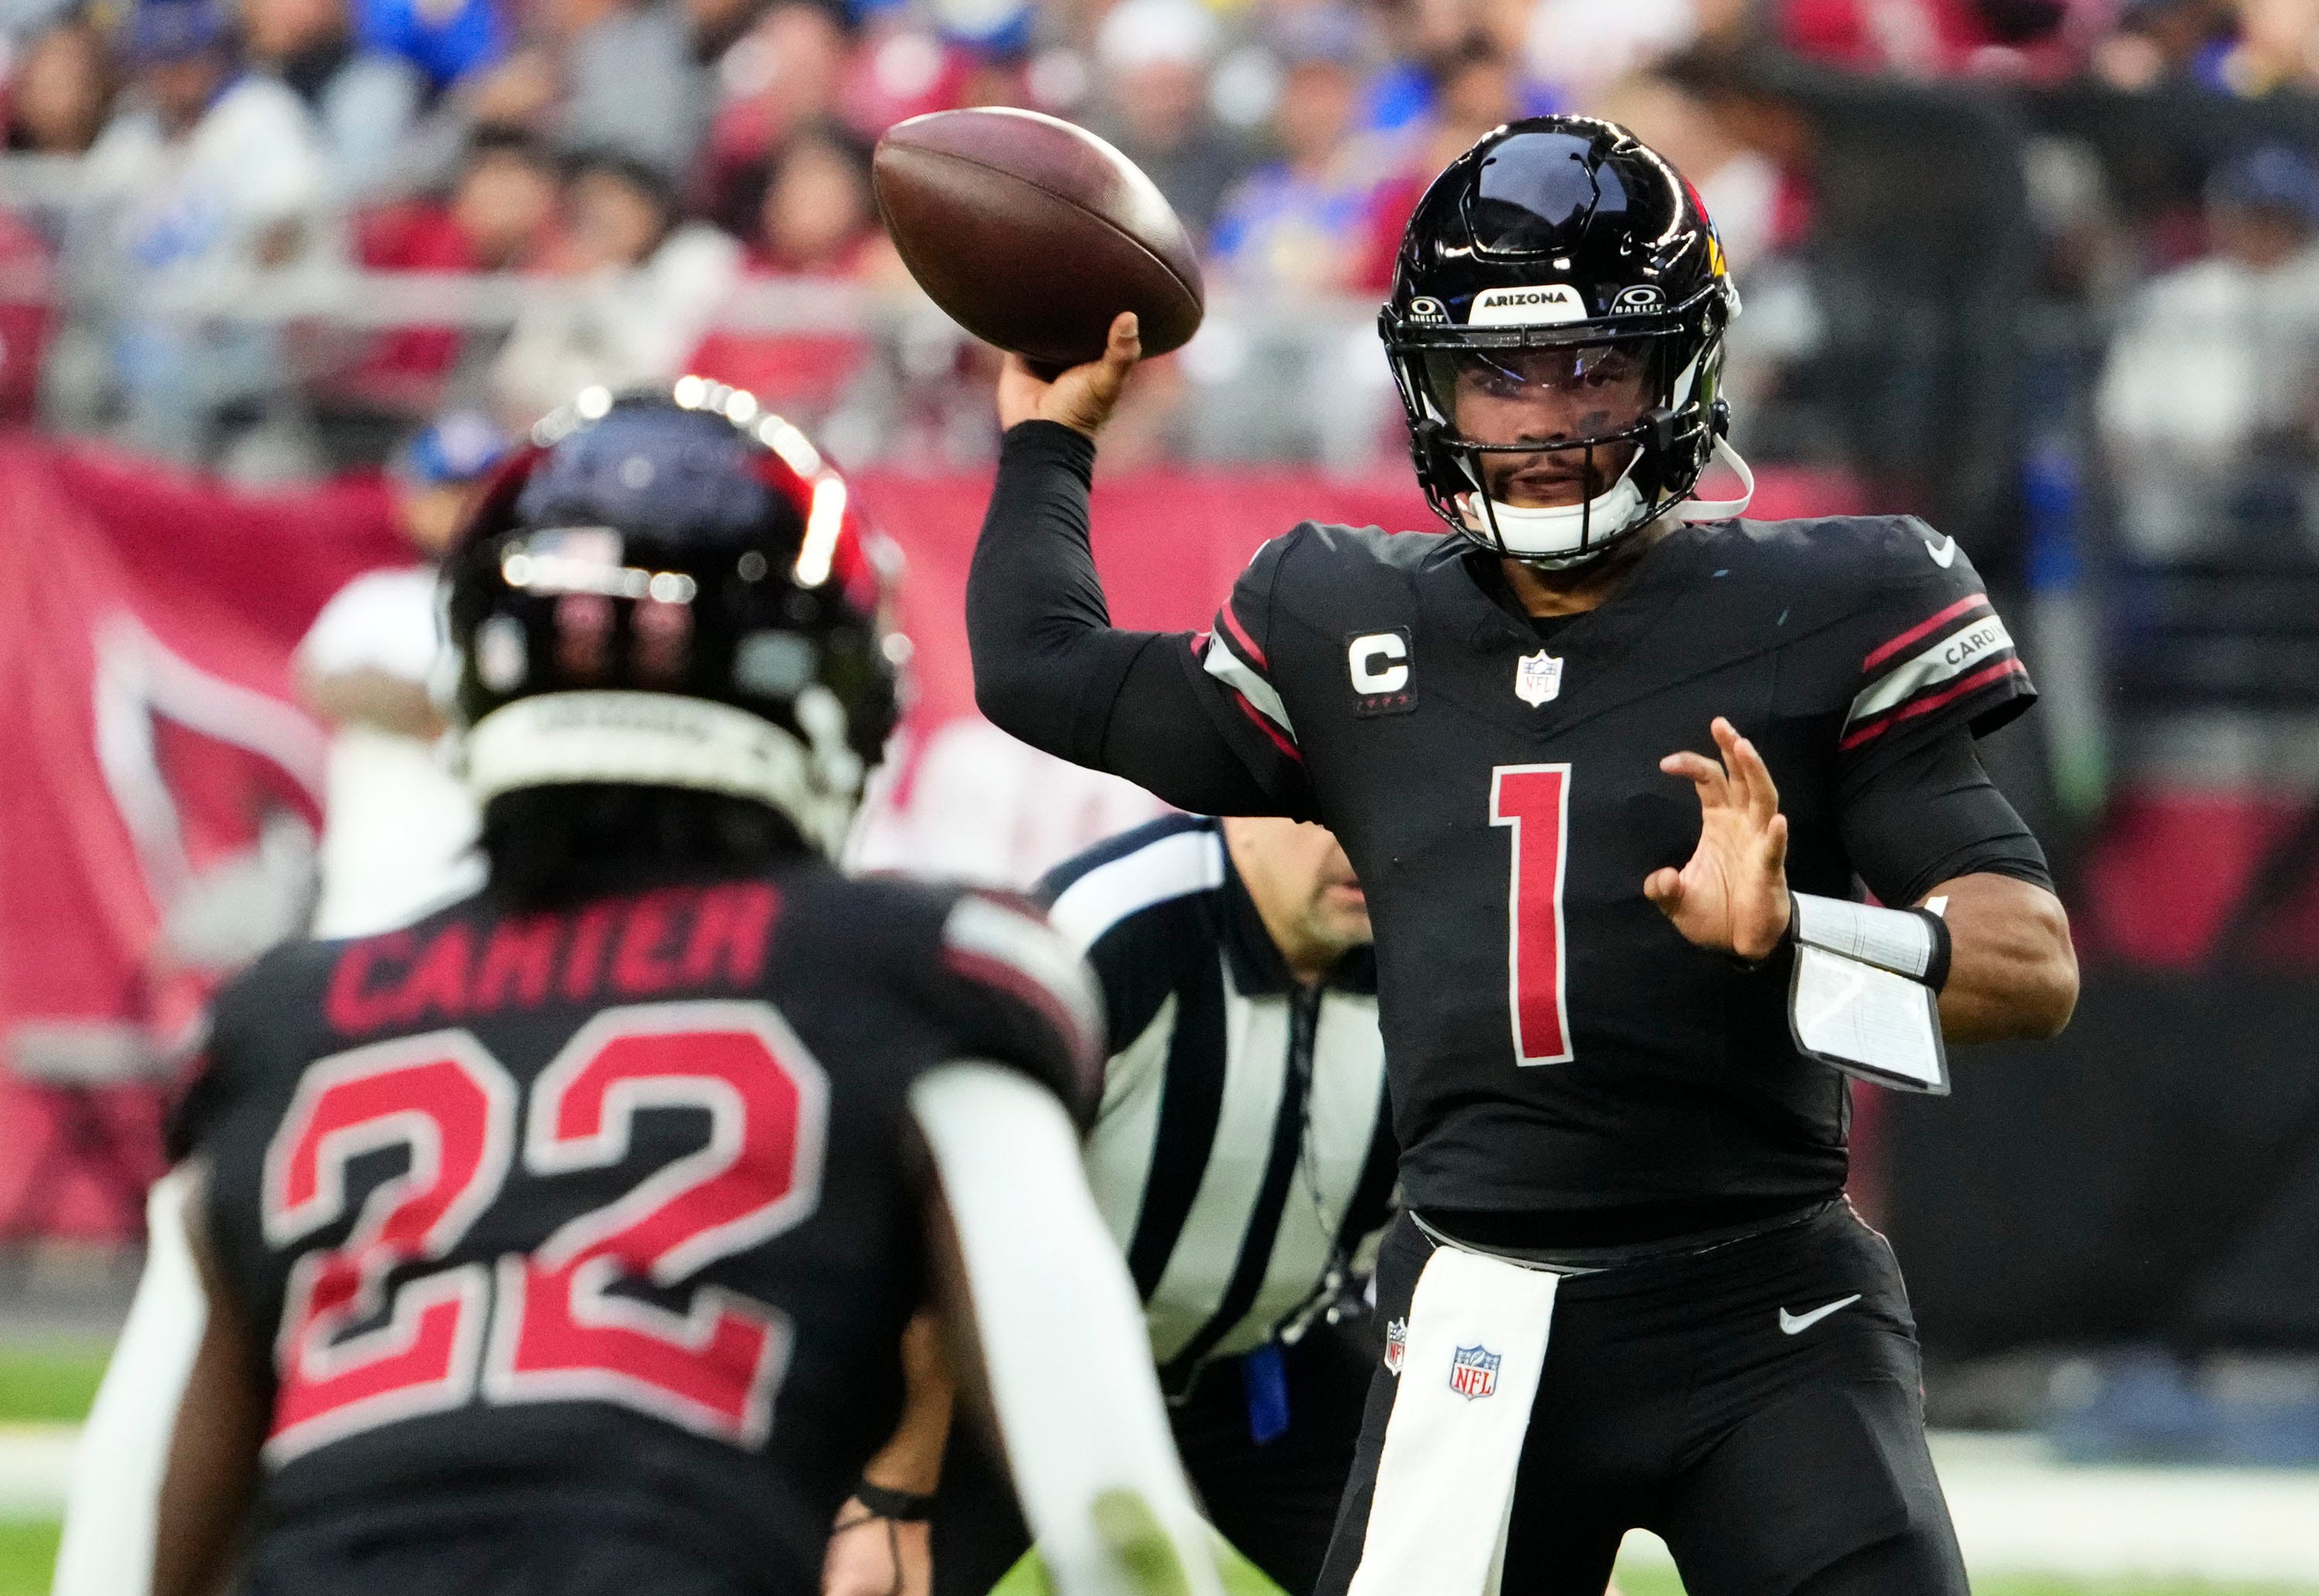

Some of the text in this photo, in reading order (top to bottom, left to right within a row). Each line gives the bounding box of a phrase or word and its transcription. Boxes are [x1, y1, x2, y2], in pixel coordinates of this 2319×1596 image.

[1483, 291, 1568, 308] ARIZONA
[1616, 304, 1663, 314] OAKLEY
[1409, 314, 1443, 322] OAKLEY
[1349, 633, 1408, 695] C
[1526, 675, 1551, 693] NFL
[1490, 763, 1574, 1067] 1
[325, 881, 781, 1034] CARTER
[261, 999, 831, 1471] 22
[1454, 1366, 1492, 1396] NFL
